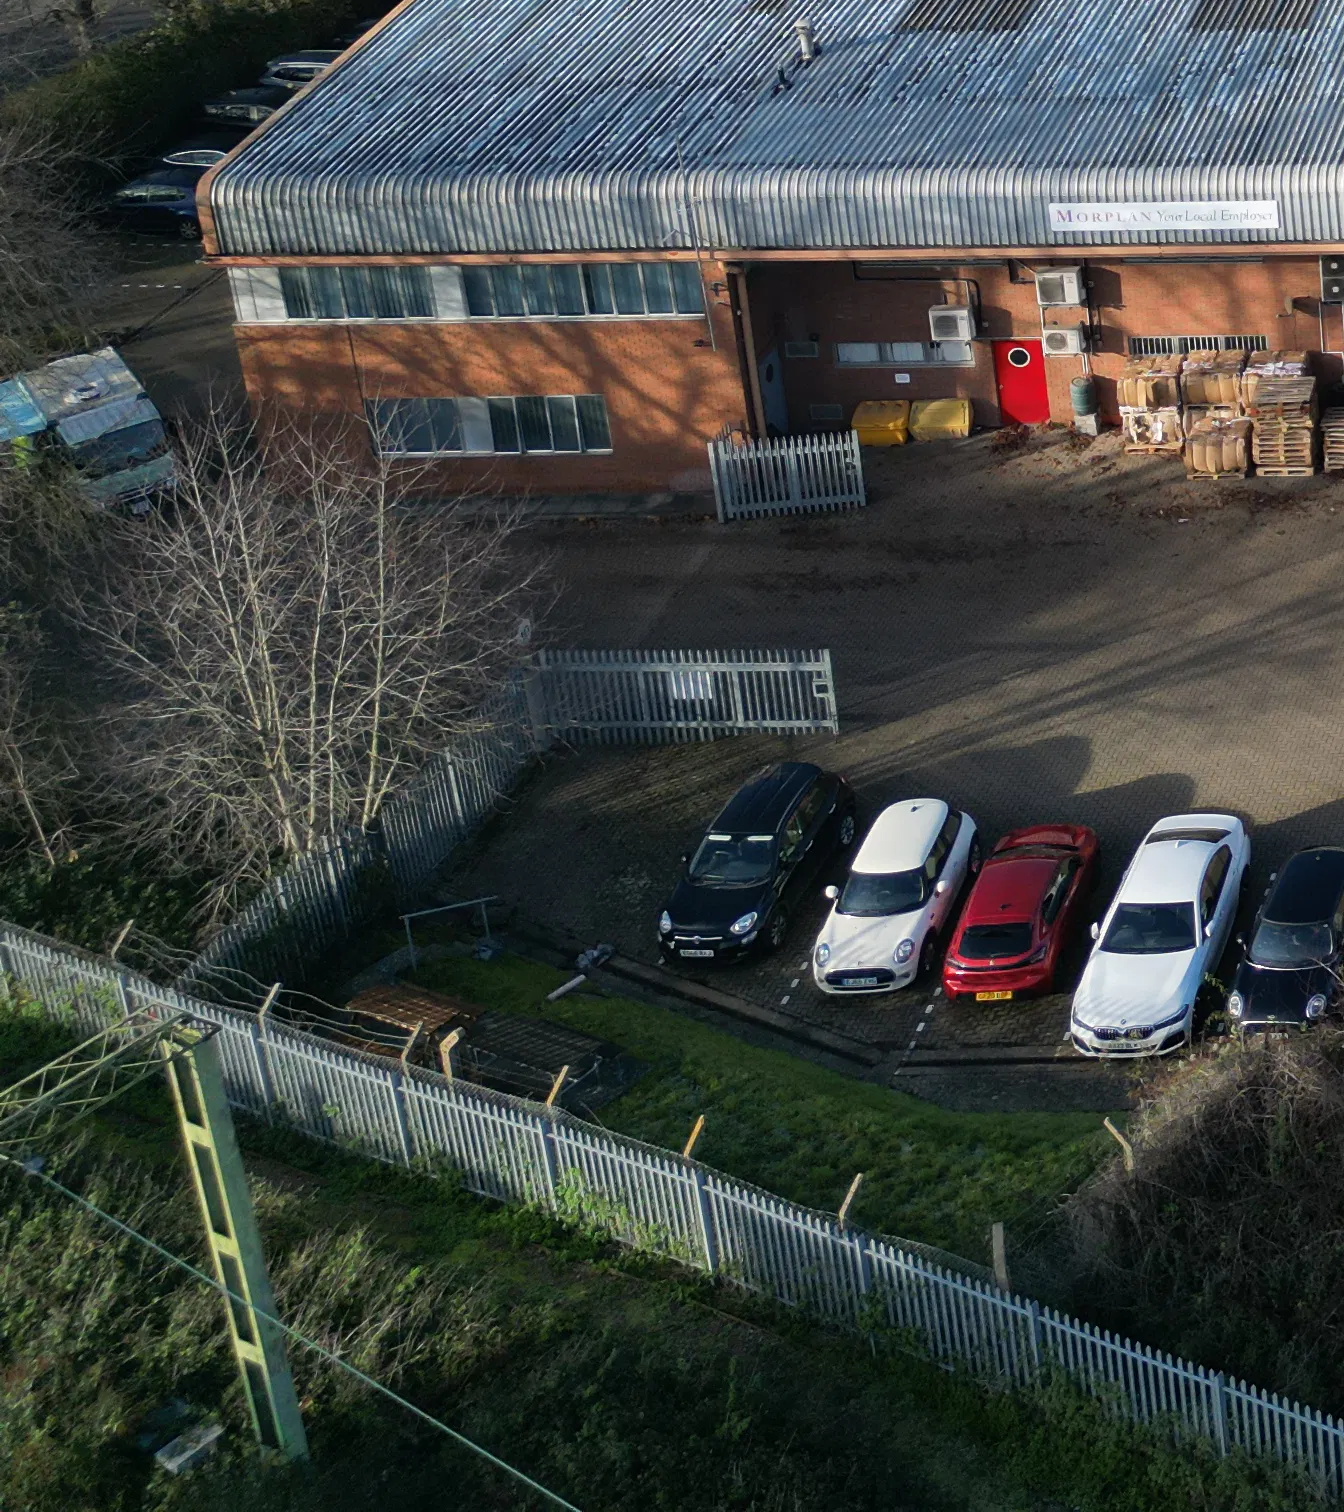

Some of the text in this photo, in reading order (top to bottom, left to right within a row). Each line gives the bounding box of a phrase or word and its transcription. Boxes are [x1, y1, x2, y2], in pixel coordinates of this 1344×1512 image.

[1056, 208, 1273, 223] MORPLAN Your Local Employer
